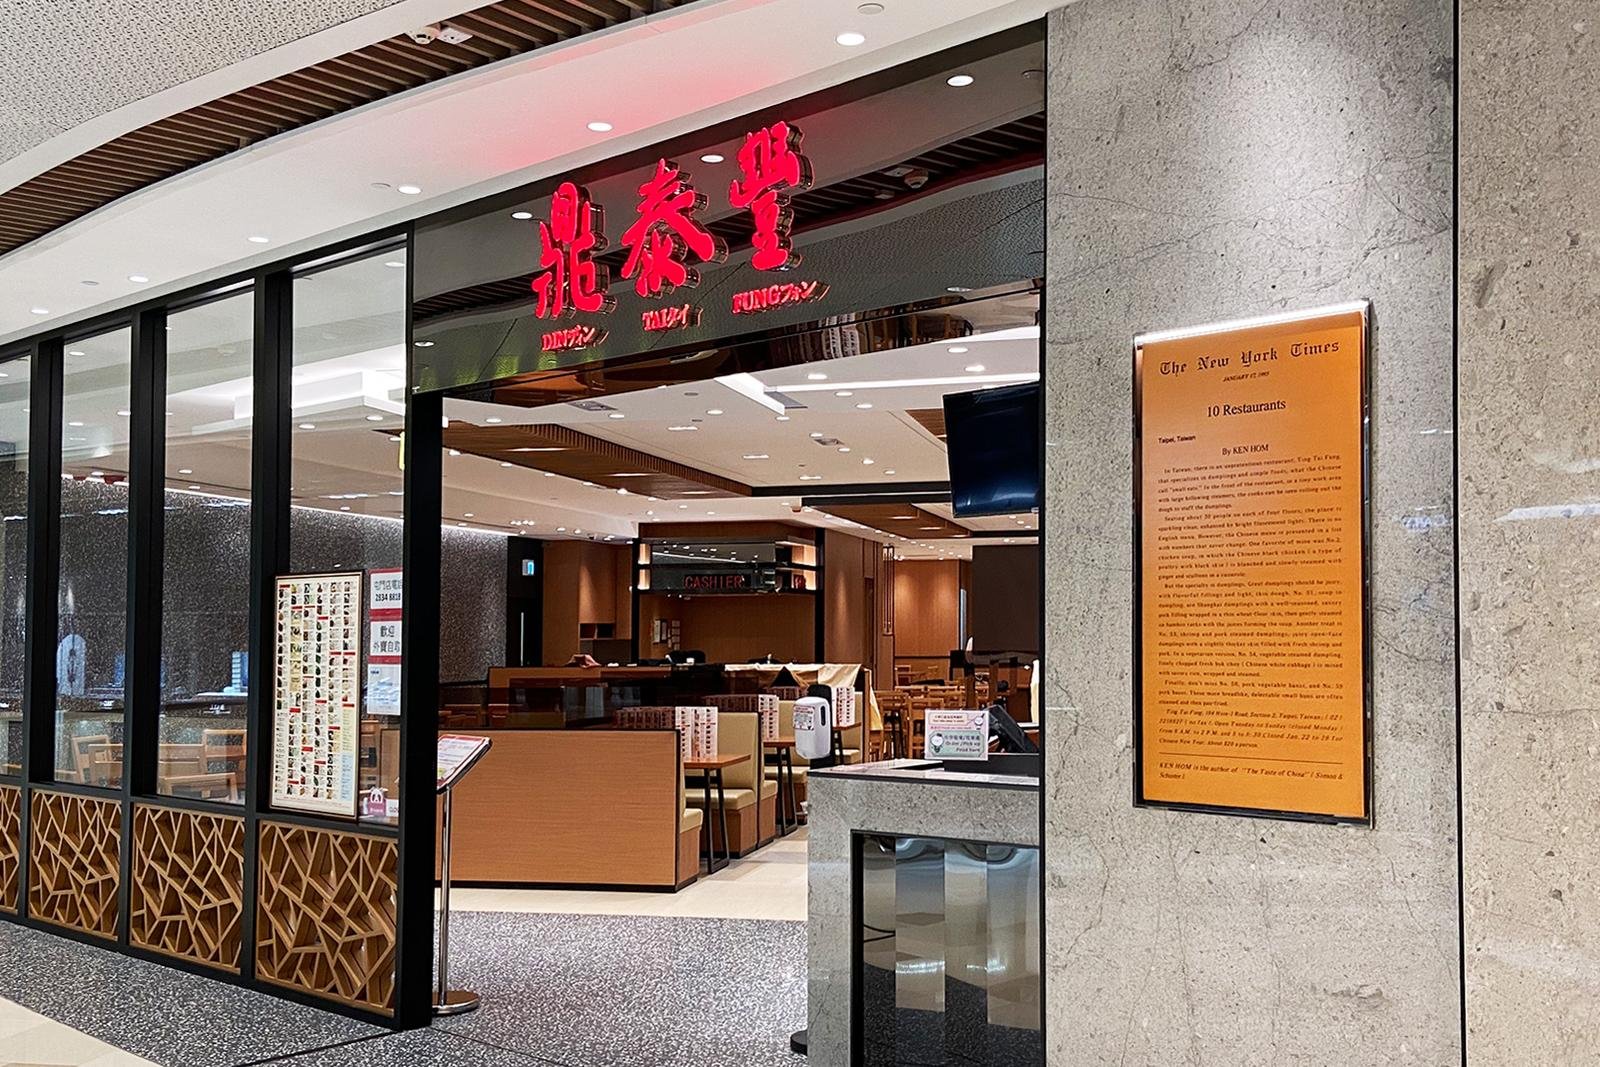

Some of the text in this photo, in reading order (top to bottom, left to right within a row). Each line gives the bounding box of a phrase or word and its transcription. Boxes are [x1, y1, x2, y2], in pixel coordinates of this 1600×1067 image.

[1160, 337, 1338, 378] The New York Times
[1207, 397, 1286, 417] 10 Restaurants
[1176, 433, 1196, 442] Taiwan
[1222, 443, 1268, 456] By KEN HOM
[684, 575, 743, 590] CASHIER
